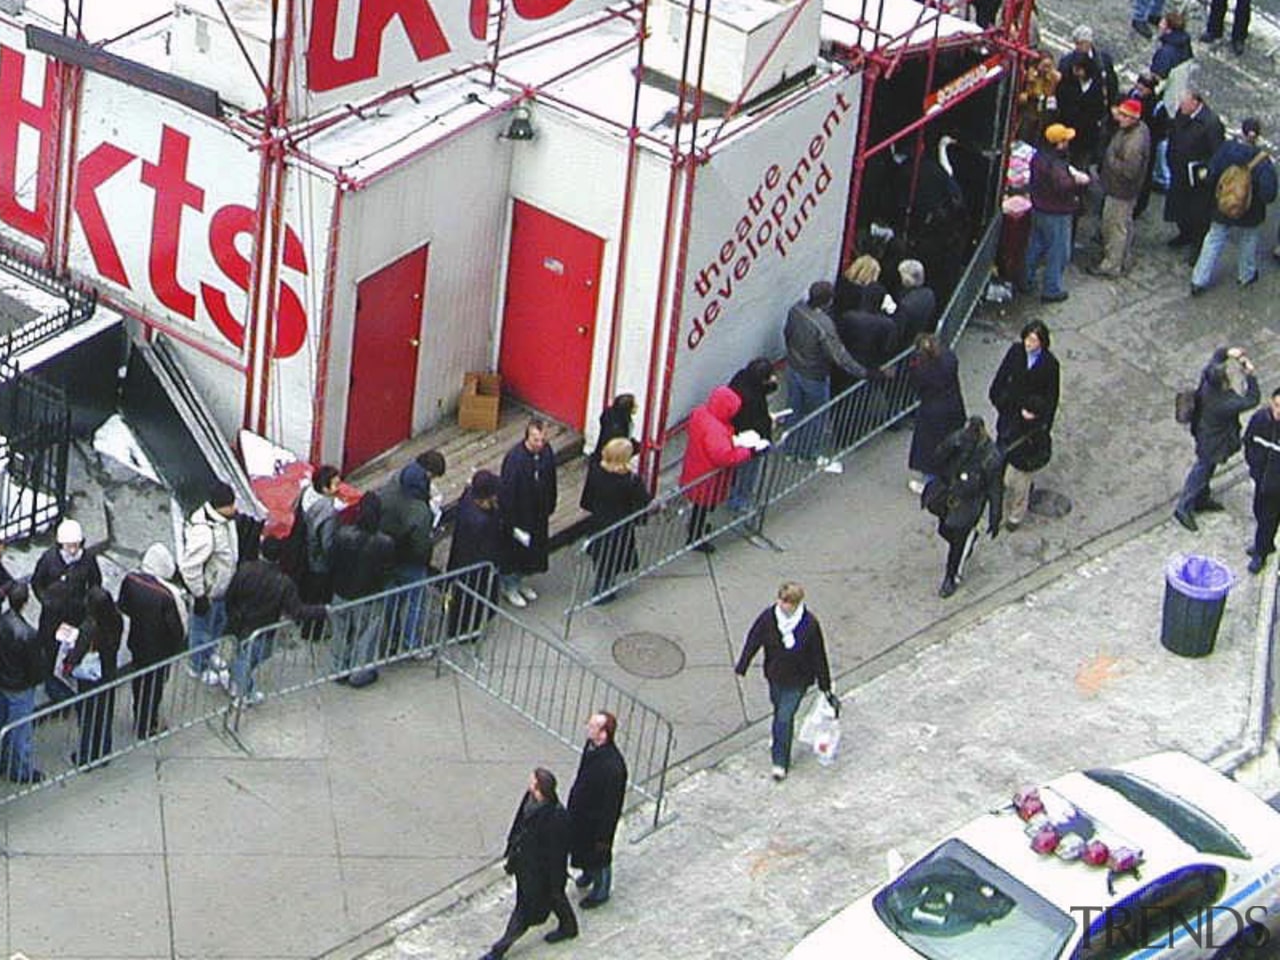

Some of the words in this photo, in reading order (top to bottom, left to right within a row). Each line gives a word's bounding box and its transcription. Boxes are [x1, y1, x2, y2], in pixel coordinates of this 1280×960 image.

[687, 91, 852, 351] development
[693, 162, 782, 299] theatre
[774, 161, 834, 258] fund
